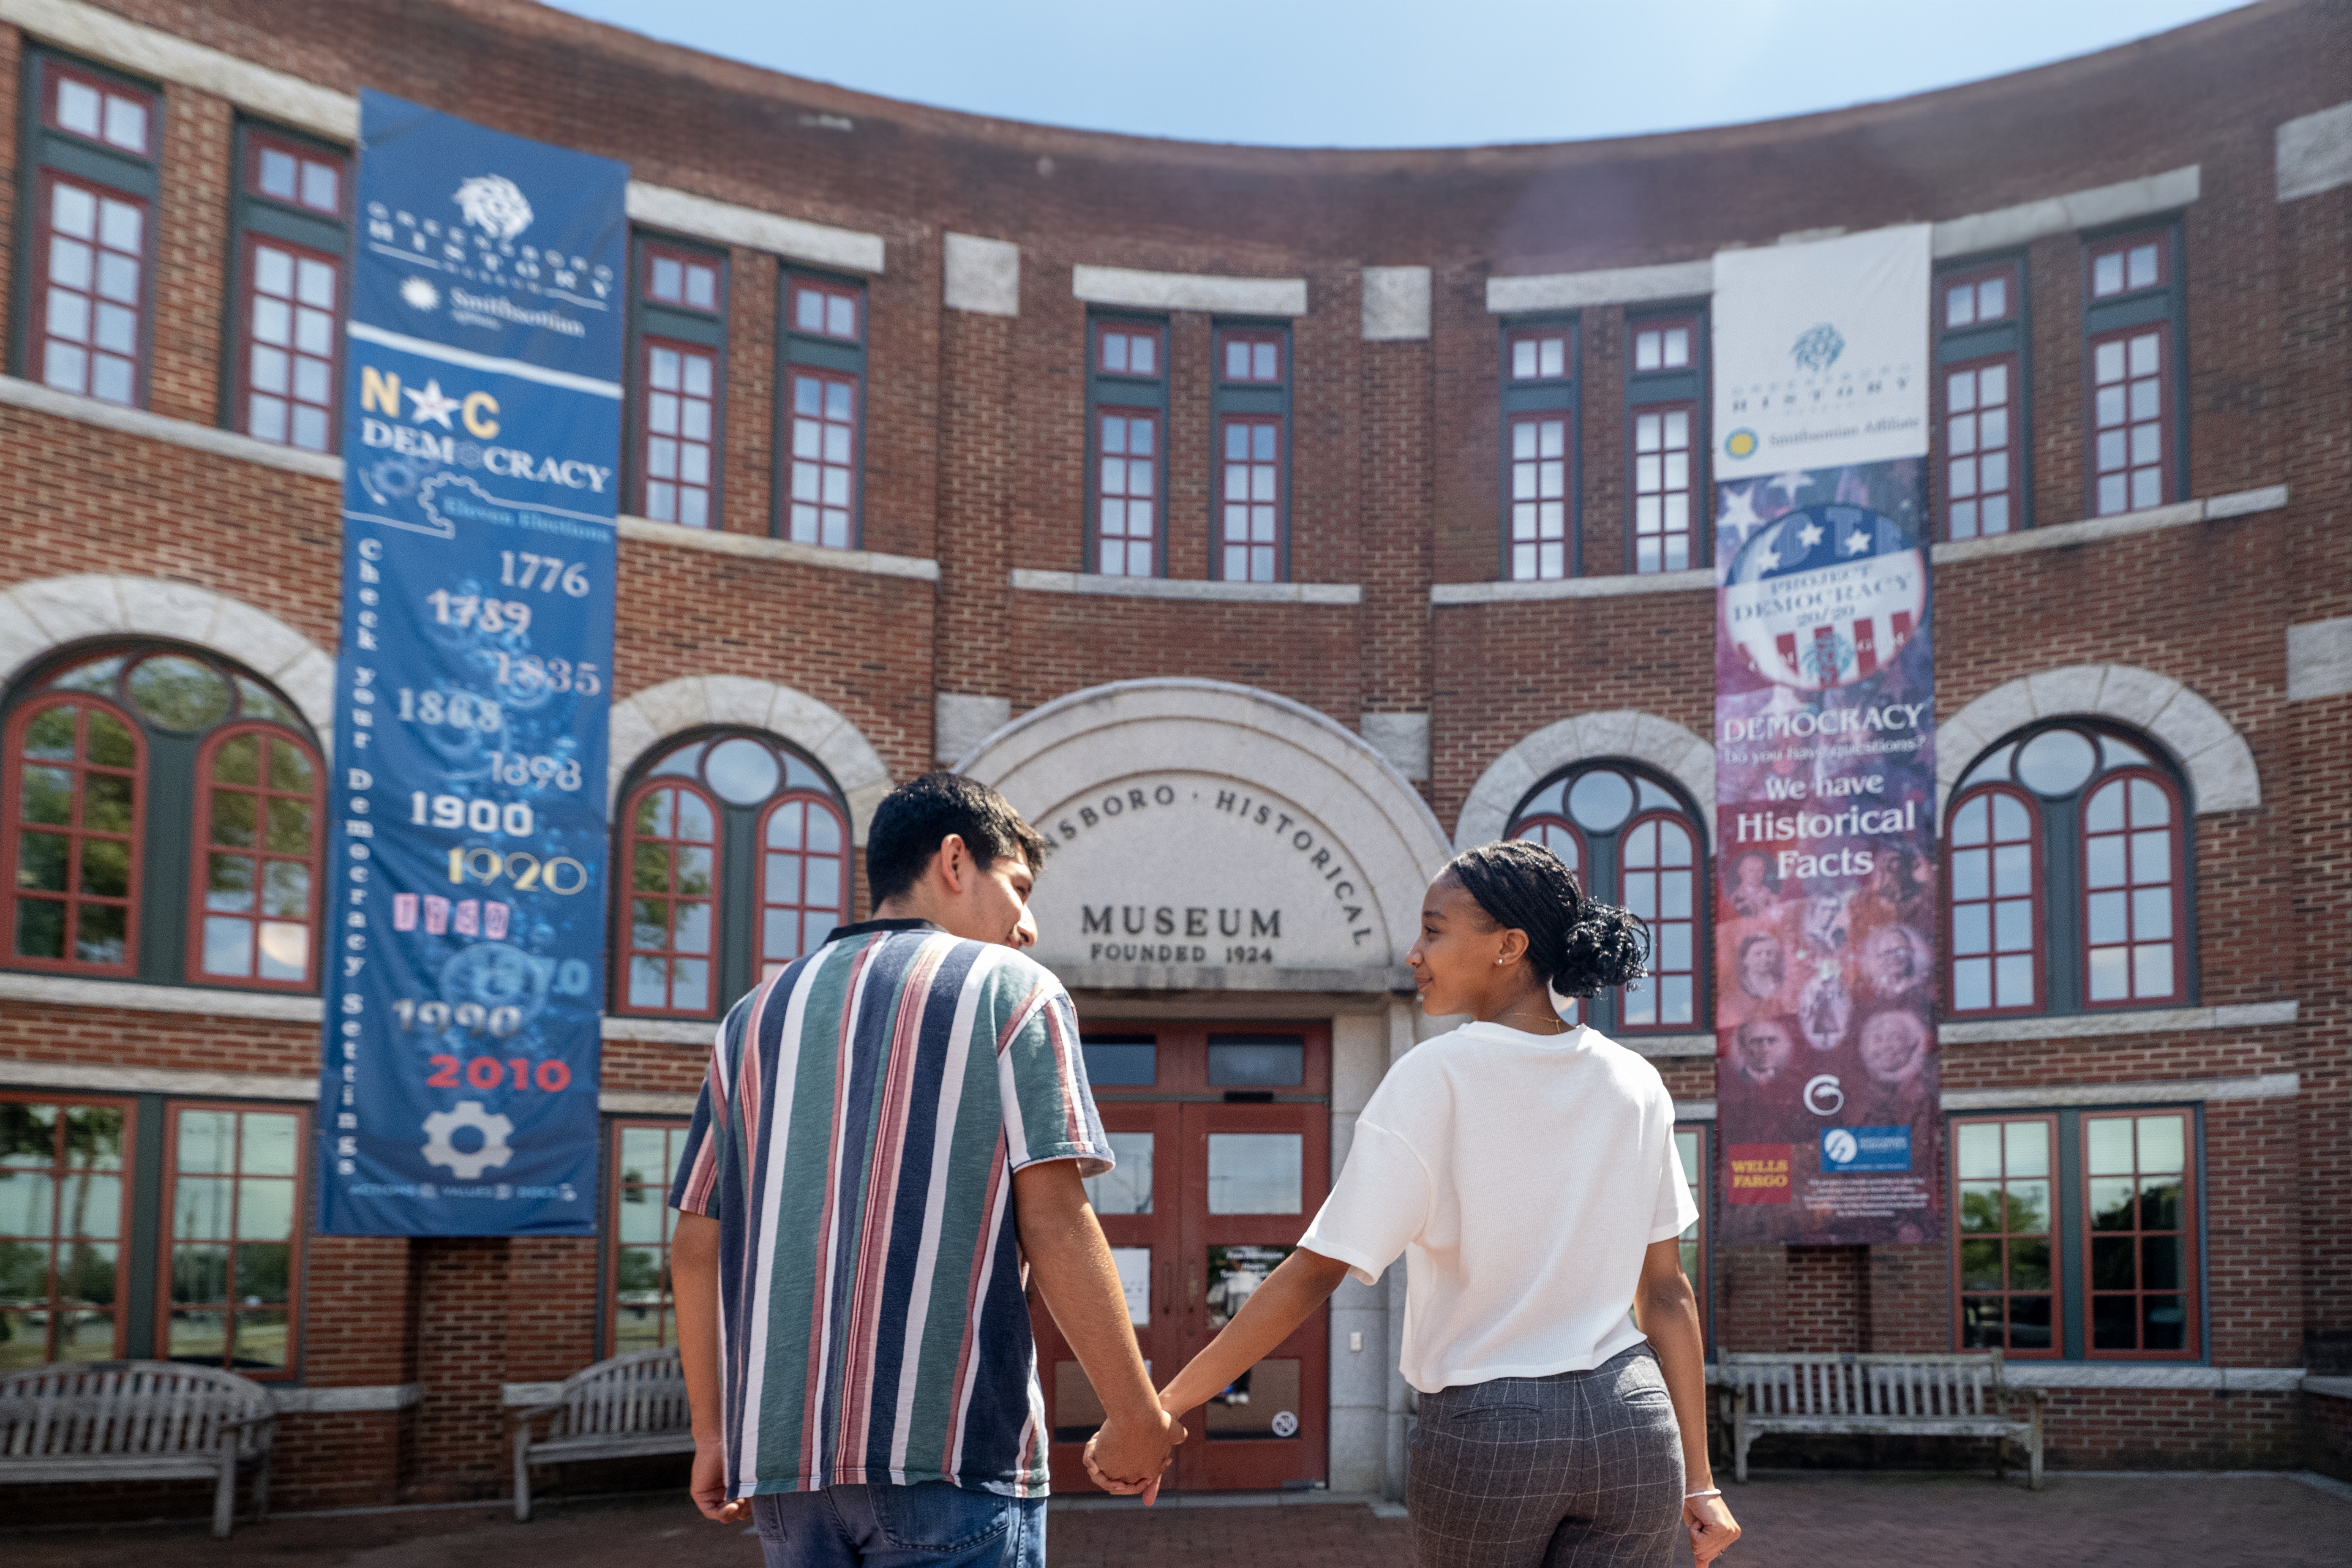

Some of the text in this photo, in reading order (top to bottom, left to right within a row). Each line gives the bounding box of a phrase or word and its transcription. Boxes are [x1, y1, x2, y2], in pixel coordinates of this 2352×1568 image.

[450, 286, 586, 338] Smithsonian
[1769, 415, 1921, 448] Smithsonian Affiliate
[518, 510, 613, 544] Elections
[501, 549, 591, 598] 1776
[1770, 563, 1874, 594] PROJECT
[426, 588, 532, 635] 1789
[1734, 571, 1913, 622] DEMOCRACY
[493, 650, 602, 697] 1835
[1724, 703, 1925, 744] DEMOCRACY
[1751, 751, 1783, 767] you
[1786, 745, 1830, 761] have
[1830, 734, 1927, 759] questions?
[485, 750, 583, 792] 1898
[1765, 772, 1885, 801] We have
[410, 790, 534, 837] 1900
[1736, 799, 1916, 844] Historical
[448, 846, 589, 895] 1920
[1215, 789, 1373, 946] HISTORICAL
[1777, 847, 1875, 880] Facts
[1081, 904, 1282, 938] MUSEUM
[1090, 942, 1274, 964] FOUNDED 1924
[427, 1053, 571, 1093] 2010
[1731, 1159, 1788, 1173] WELLS
[1733, 1174, 1788, 1188] FARGO
